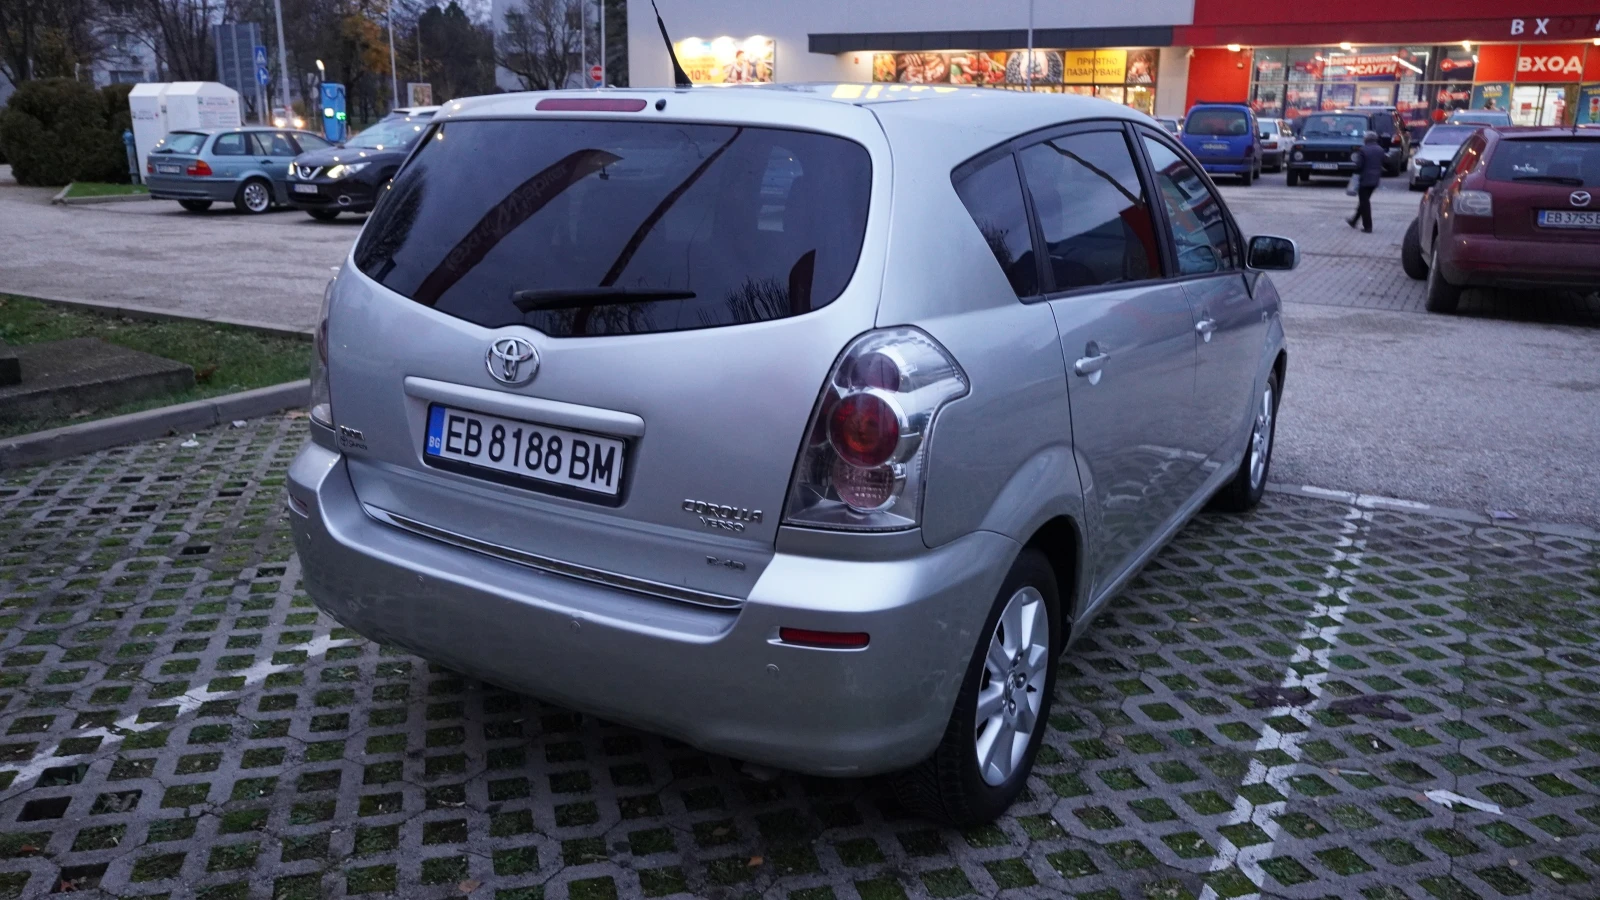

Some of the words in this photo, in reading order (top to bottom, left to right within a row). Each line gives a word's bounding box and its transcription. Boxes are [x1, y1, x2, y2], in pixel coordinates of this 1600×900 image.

[1076, 56, 1118, 65] ПРИЯТНО
[1518, 56, 1583, 75] ВХОД
[1066, 67, 1122, 77] ПАЗАРУВАНЕ
[428, 435, 441, 449] BG
[682, 498, 764, 523] COROLLA
[699, 515, 745, 532] VERSO
